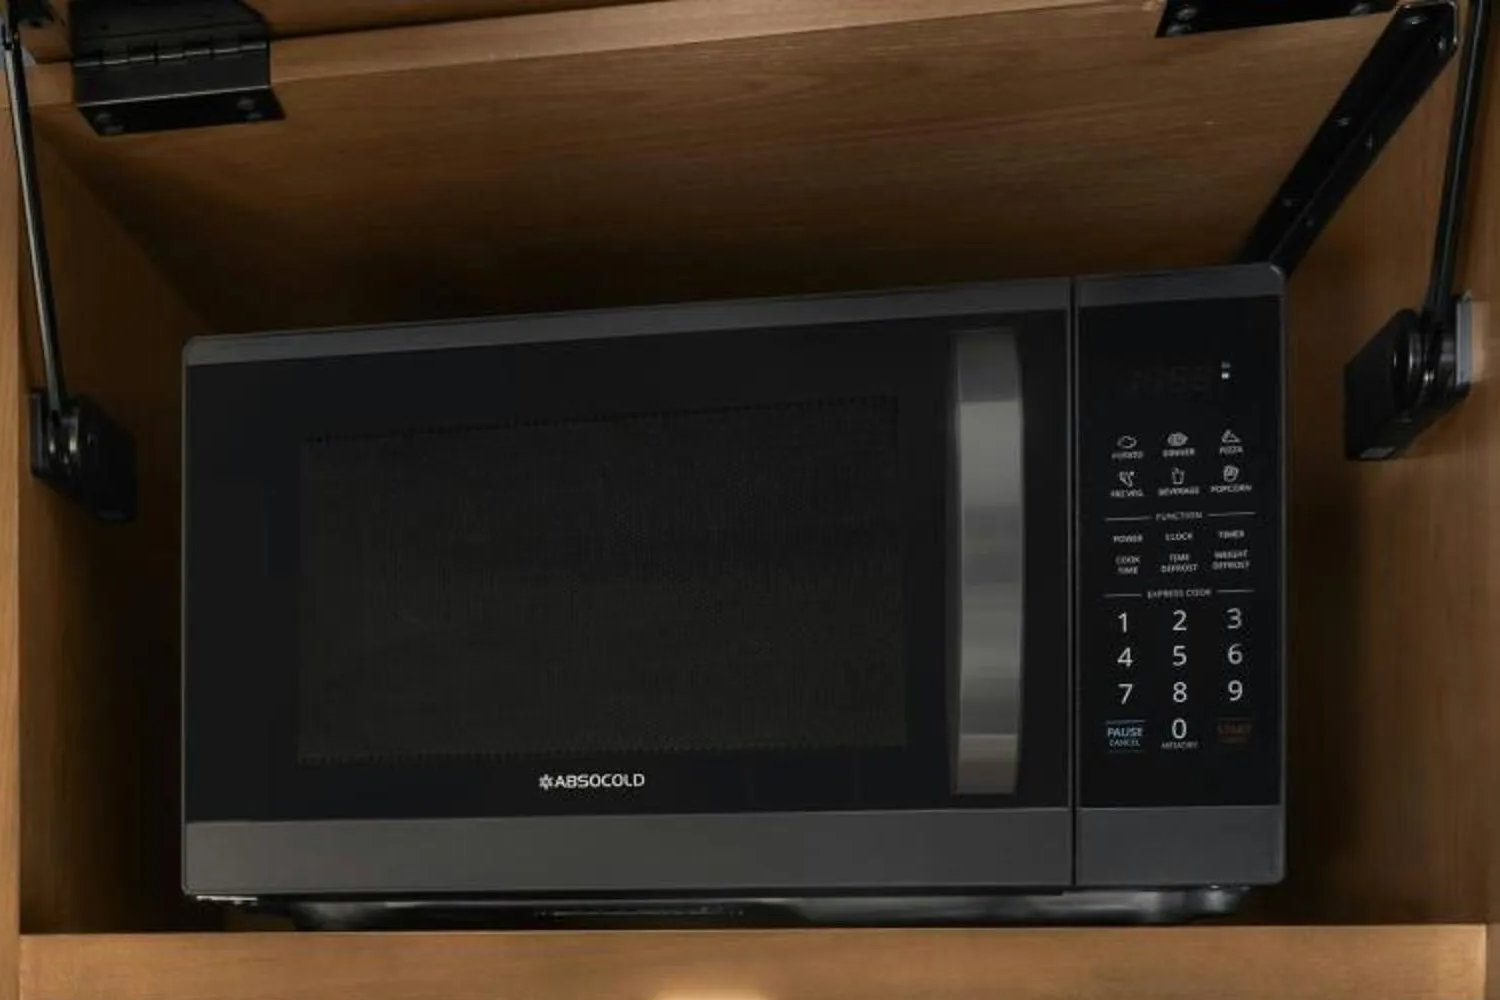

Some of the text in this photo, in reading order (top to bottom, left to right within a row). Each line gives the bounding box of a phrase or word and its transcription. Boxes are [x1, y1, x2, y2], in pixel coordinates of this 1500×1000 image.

[1210, 484, 1252, 493] POPCORN
[1113, 534, 1143, 543] POWER
[1118, 612, 1127, 633] 1
[1172, 609, 1187, 631] 2
[1227, 608, 1242, 629] 3
[1117, 647, 1134, 667] 4
[1173, 645, 1187, 666] 5
[1228, 643, 1243, 664] 6
[1118, 683, 1133, 704] 7
[1173, 682, 1188, 703] 8
[1228, 680, 1243, 701] 9
[1107, 727, 1143, 737] PAUSE
[1172, 718, 1187, 739] 0
[554, 774, 644, 788] ABSOCOLD
